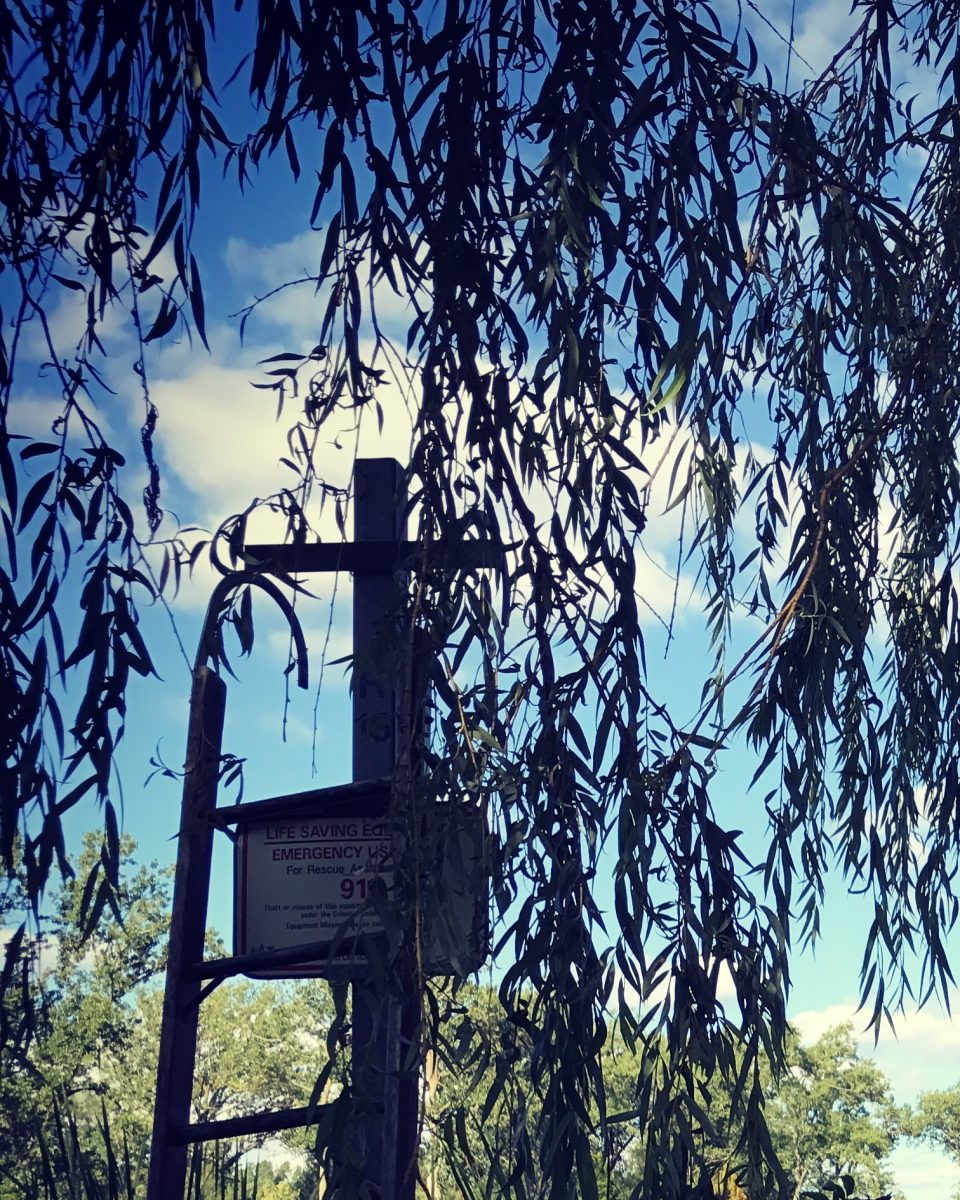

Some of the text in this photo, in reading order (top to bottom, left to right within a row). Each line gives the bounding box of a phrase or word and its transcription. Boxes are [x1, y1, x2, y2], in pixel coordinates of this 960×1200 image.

[266, 826, 296, 840] LIFE
[301, 823, 357, 839] SAVING
[272, 846, 392, 862] EMERGENCY US
[286, 865, 303, 875] For
[307, 864, 345, 875] Rescue
